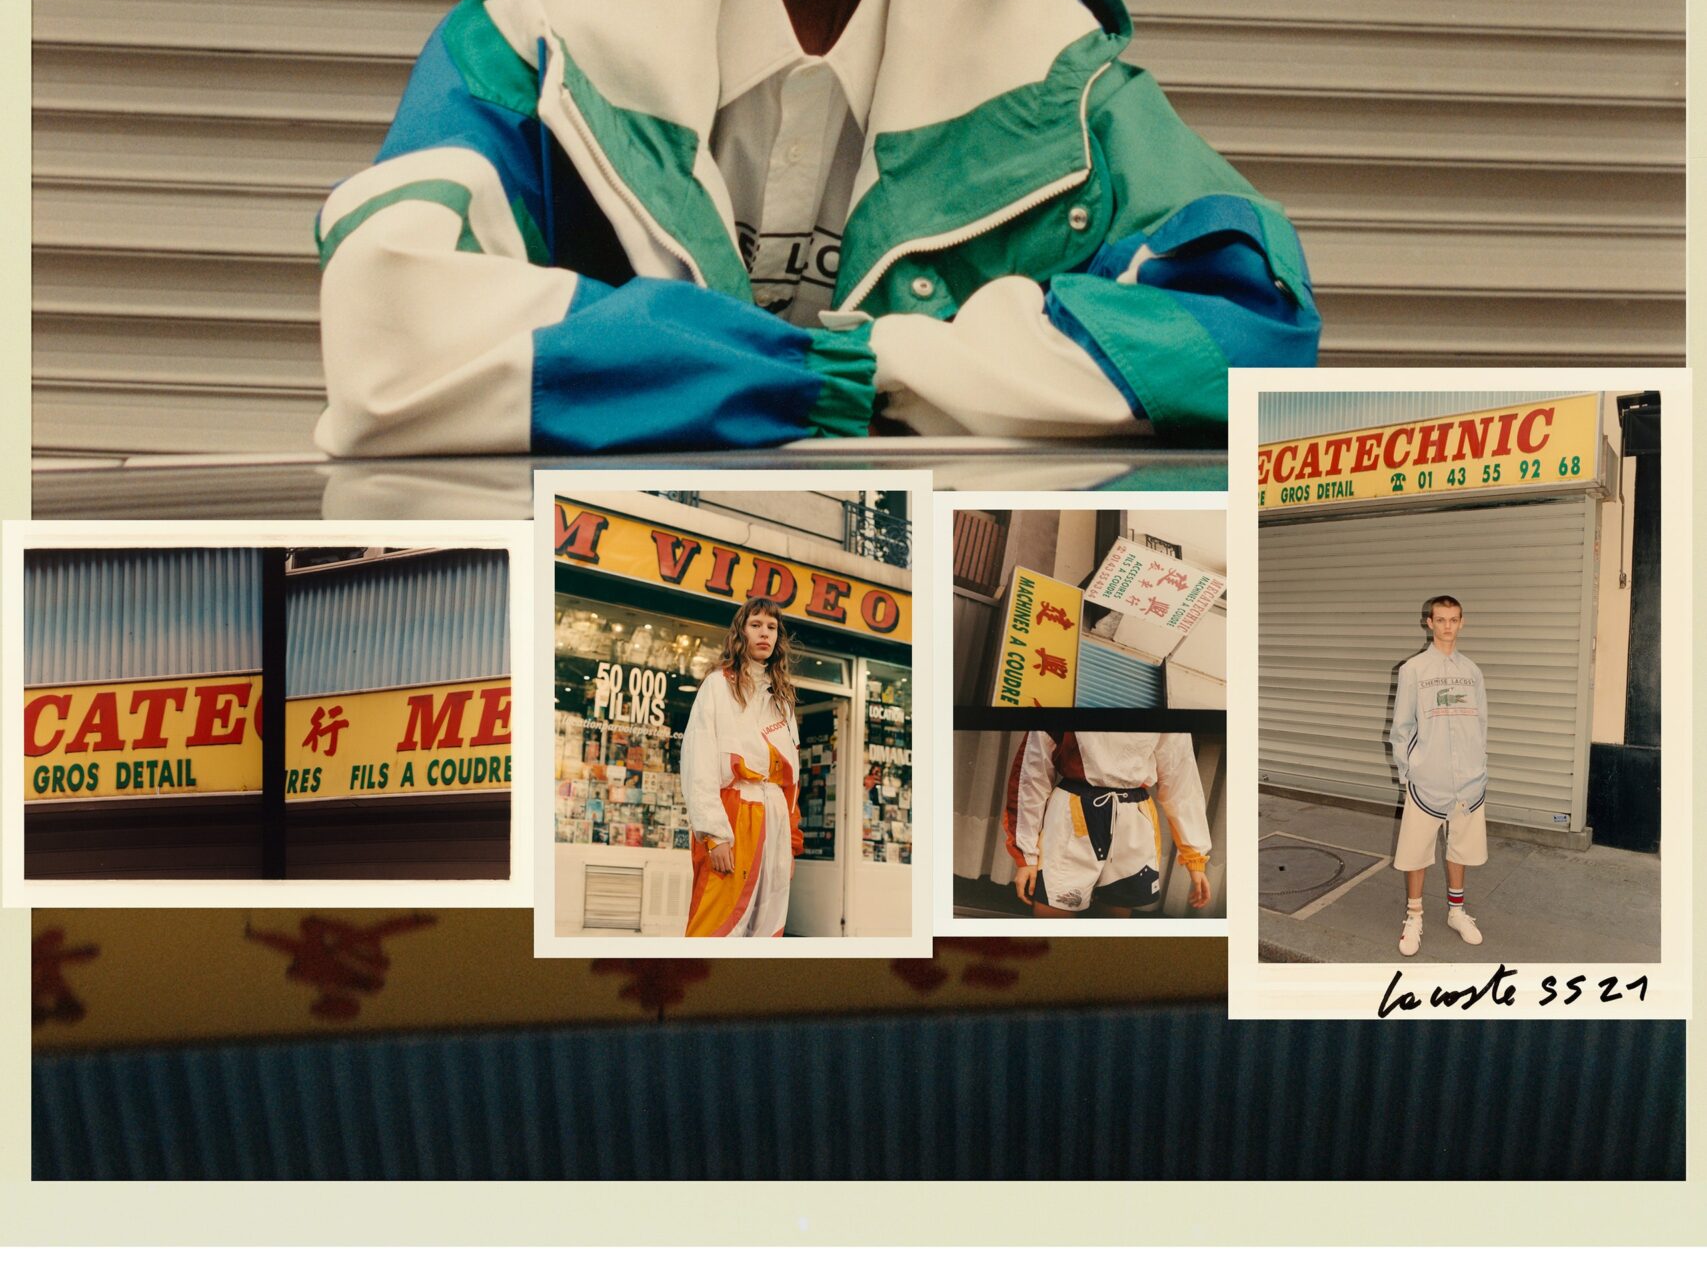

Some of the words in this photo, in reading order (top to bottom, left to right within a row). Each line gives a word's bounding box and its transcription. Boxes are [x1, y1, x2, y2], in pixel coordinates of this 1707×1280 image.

[1280, 484, 1310, 504] GROS
[1317, 479, 1354, 500] DETAIL
[1417, 470, 1433, 489] 01
[1447, 467, 1467, 486] 43
[1482, 463, 1501, 483] 55
[1519, 459, 1541, 480] 92
[1558, 455, 1581, 476] 68
[650, 530, 900, 633] VIDEO
[1012, 575, 1035, 634] MACHINES
[1102, 575, 1122, 599] COUDRE
[1113, 561, 1143, 600] ACCESSOIRES
[1009, 635, 1027, 647] A
[1033, 601, 1075, 707] 建興
[596, 662, 623, 694] 50
[628, 667, 667, 701] 000
[1000, 651, 1025, 706] COUDRE
[24, 683, 262, 757] CATE
[302, 705, 350, 757] 行
[397, 686, 511, 753] ME
[33, 761, 99, 793] GROS
[116, 759, 197, 790] DETAIL
[350, 762, 389, 791] FILS
[400, 761, 415, 788] A
[427, 755, 511, 787] COUDRE
